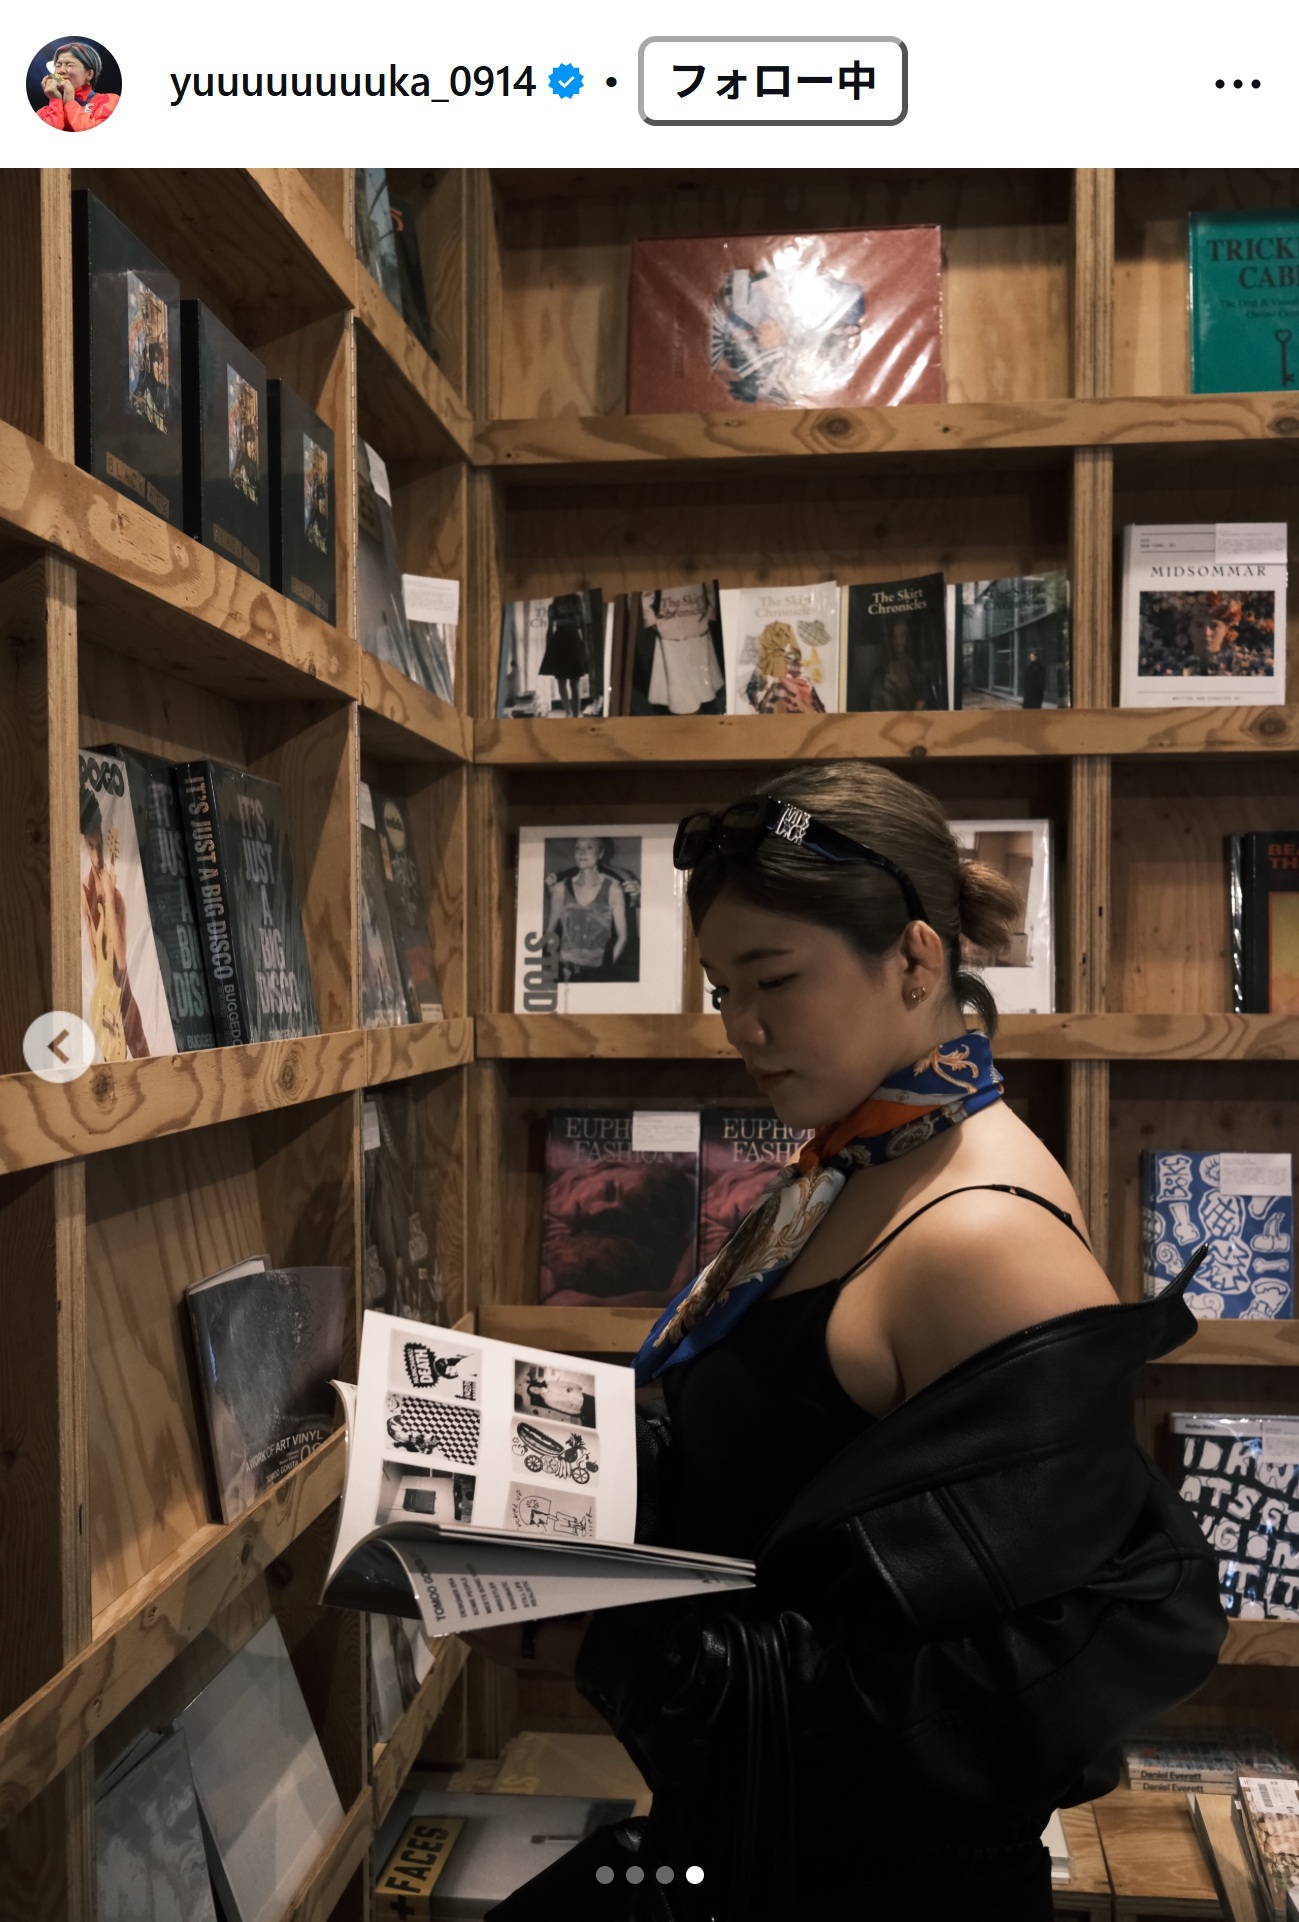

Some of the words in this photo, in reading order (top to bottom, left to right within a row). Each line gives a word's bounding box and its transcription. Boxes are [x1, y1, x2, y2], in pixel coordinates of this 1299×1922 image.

[1206, 237, 1299, 263] TRICK
[1239, 265, 1299, 289] CAB
[1151, 565, 1267, 578] MIDSOMMAR
[867, 598, 928, 615] Chronicles
[872, 591, 895, 604] The
[896, 588, 923, 601] Skirt
[184, 776, 210, 815] IT'S
[236, 795, 267, 842] IT'S
[190, 820, 217, 863] JUST
[198, 868, 219, 882] A
[242, 838, 275, 884] JUST
[201, 884, 225, 918] BIG
[260, 884, 273, 926] A
[206, 920, 234, 980] DISCO
[258, 927, 288, 970] BIG
[256, 970, 302, 1014] DISCO
[564, 1117, 632, 1139] EUPH
[414, 1348, 434, 1383] DEATH
[273, 1436, 291, 1454] ART
[291, 1429, 324, 1447] VINYL
[1183, 1437, 1257, 1476] IDK
[426, 1585, 446, 1622] TOMOO
[1141, 1770, 1168, 1779] Daniel
[1170, 1771, 1202, 1780] Everett
[1143, 1782, 1170, 1790] Daniel
[1172, 1783, 1204, 1792] Everett
[384, 1825, 449, 1894] FACES
